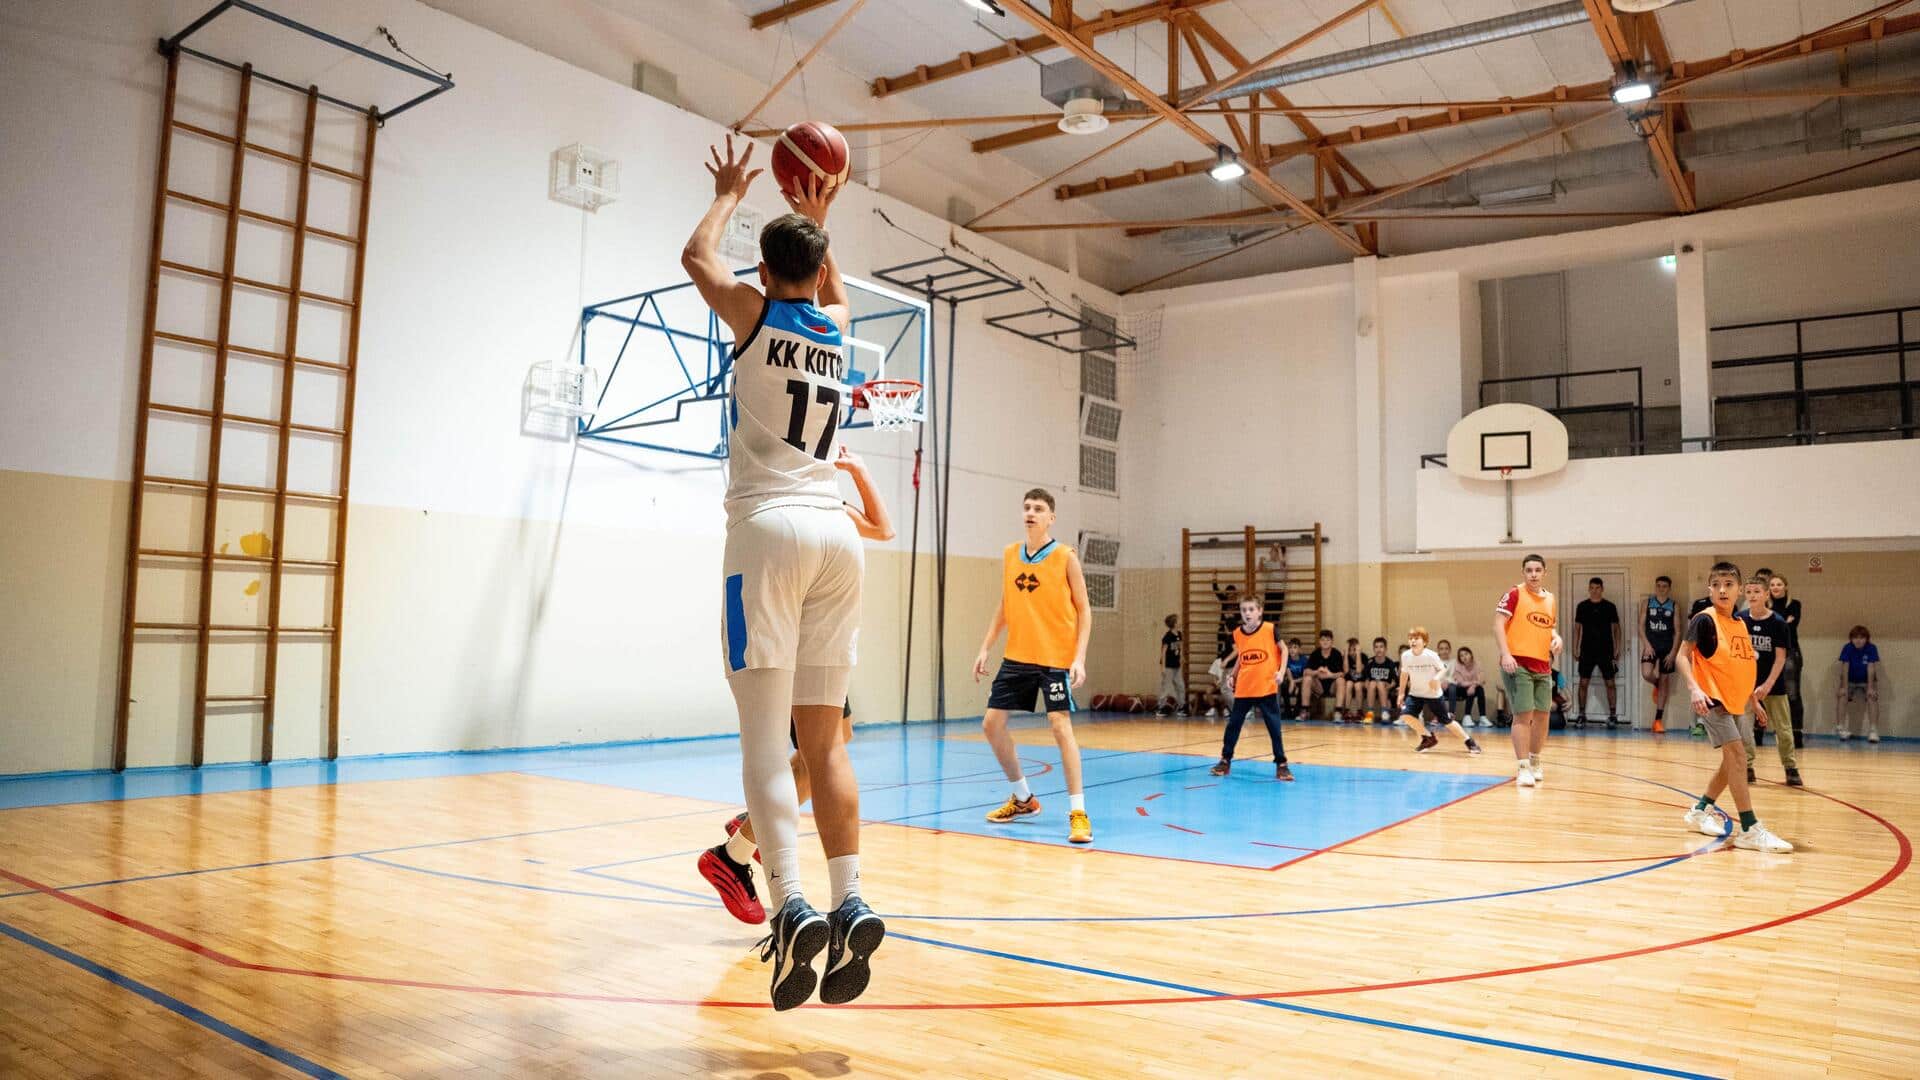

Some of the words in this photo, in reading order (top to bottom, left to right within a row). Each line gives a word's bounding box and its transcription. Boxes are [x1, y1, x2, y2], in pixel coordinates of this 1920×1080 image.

[766, 338, 800, 370] KK
[781, 379, 840, 460] 17
[1050, 682, 1064, 692] 21
